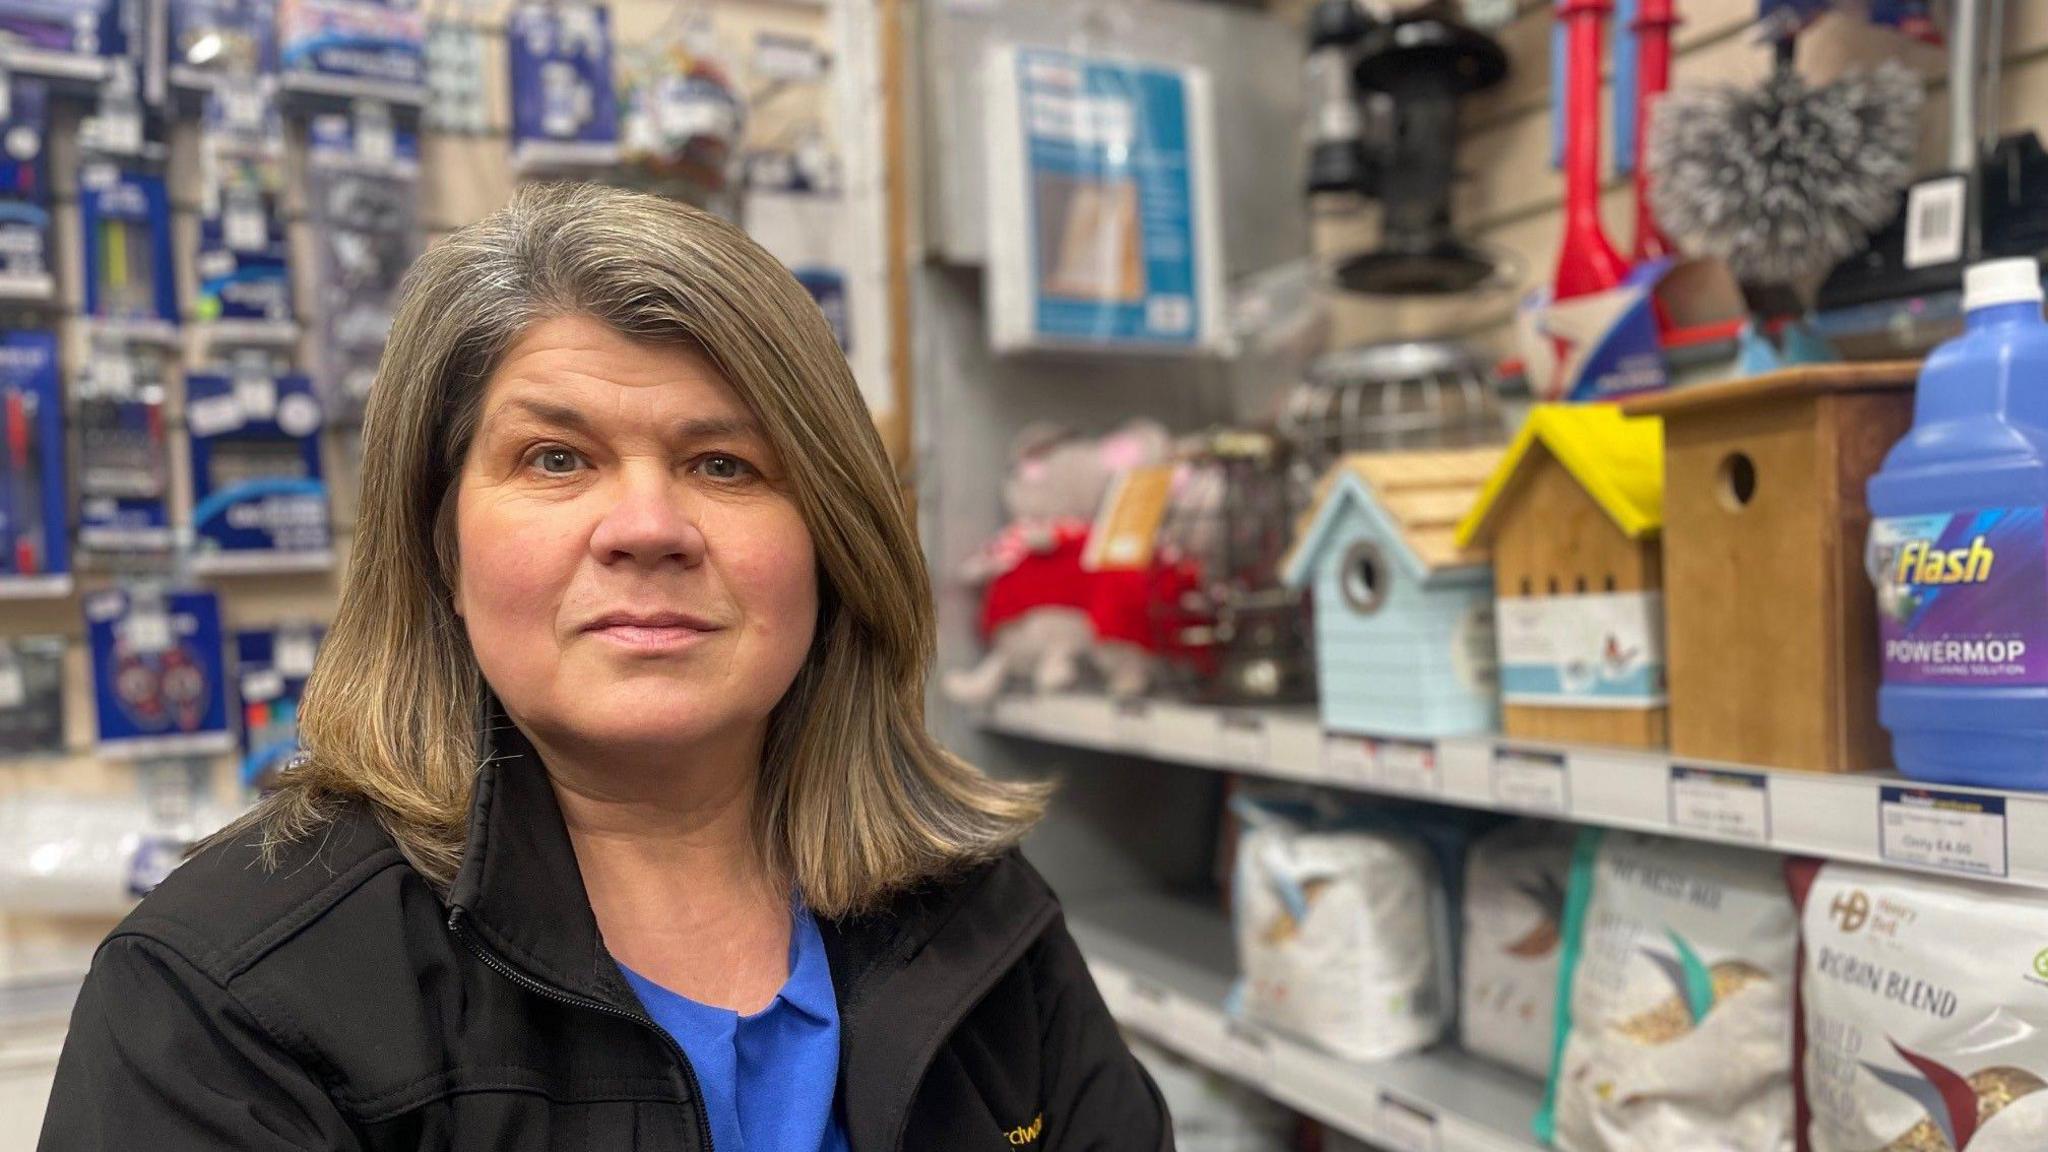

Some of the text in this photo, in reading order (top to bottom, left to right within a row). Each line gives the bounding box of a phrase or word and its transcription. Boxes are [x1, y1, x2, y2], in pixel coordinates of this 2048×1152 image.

[1896, 535, 1994, 584] Flash
[1886, 640, 2026, 662] POWERMOP
[1885, 971, 1958, 1019] BLEND
